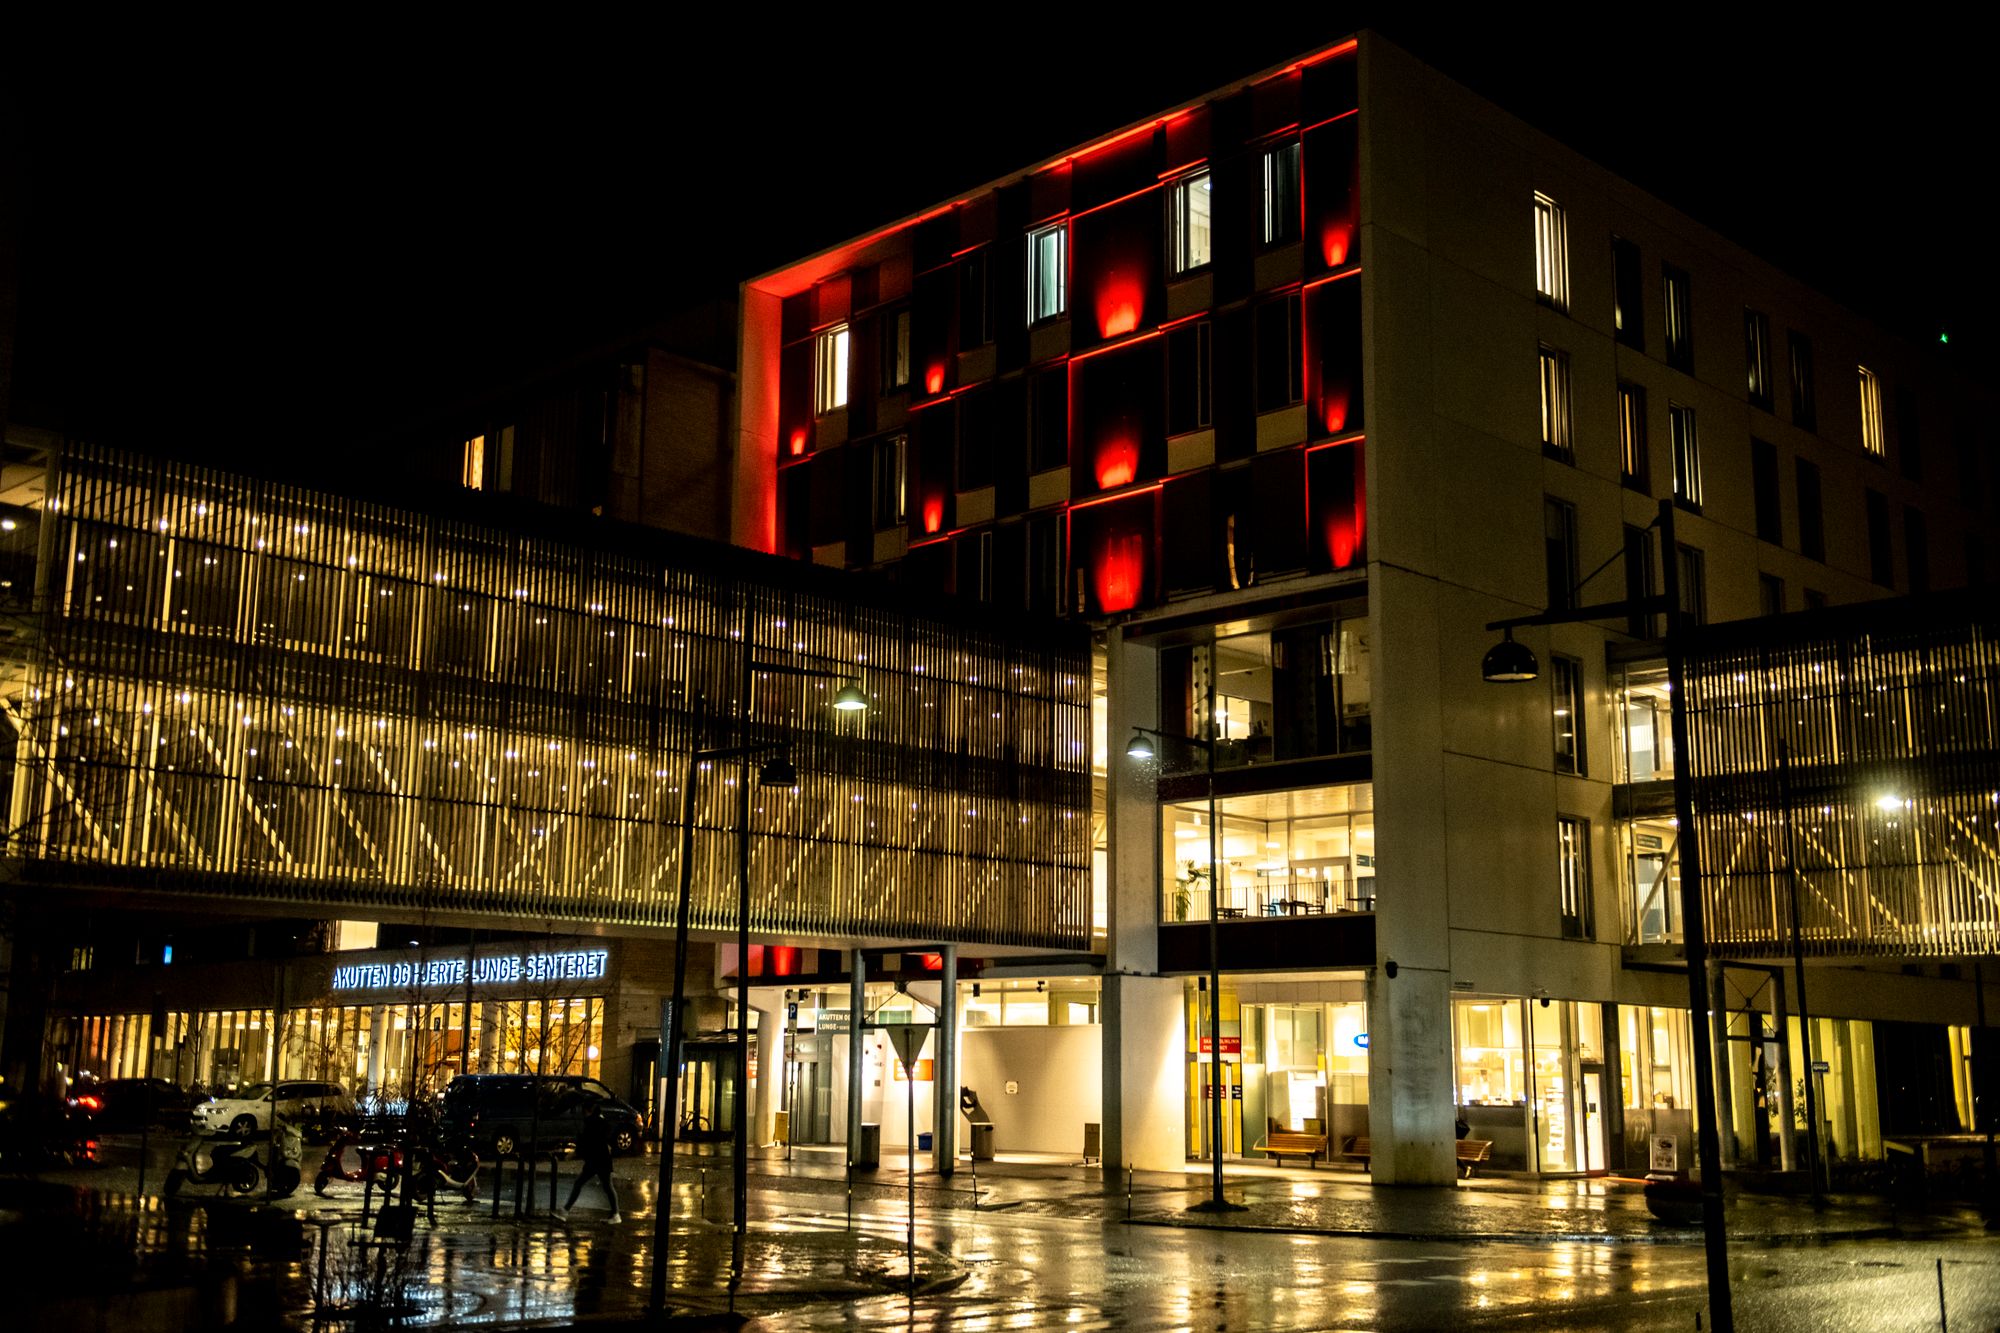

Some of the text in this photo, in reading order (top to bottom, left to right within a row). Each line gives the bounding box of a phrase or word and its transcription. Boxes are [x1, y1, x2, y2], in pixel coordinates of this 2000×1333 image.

[332, 965, 391, 989] AKUTTEN
[392, 963, 411, 986] OG
[790, 1005, 796, 1018] P
